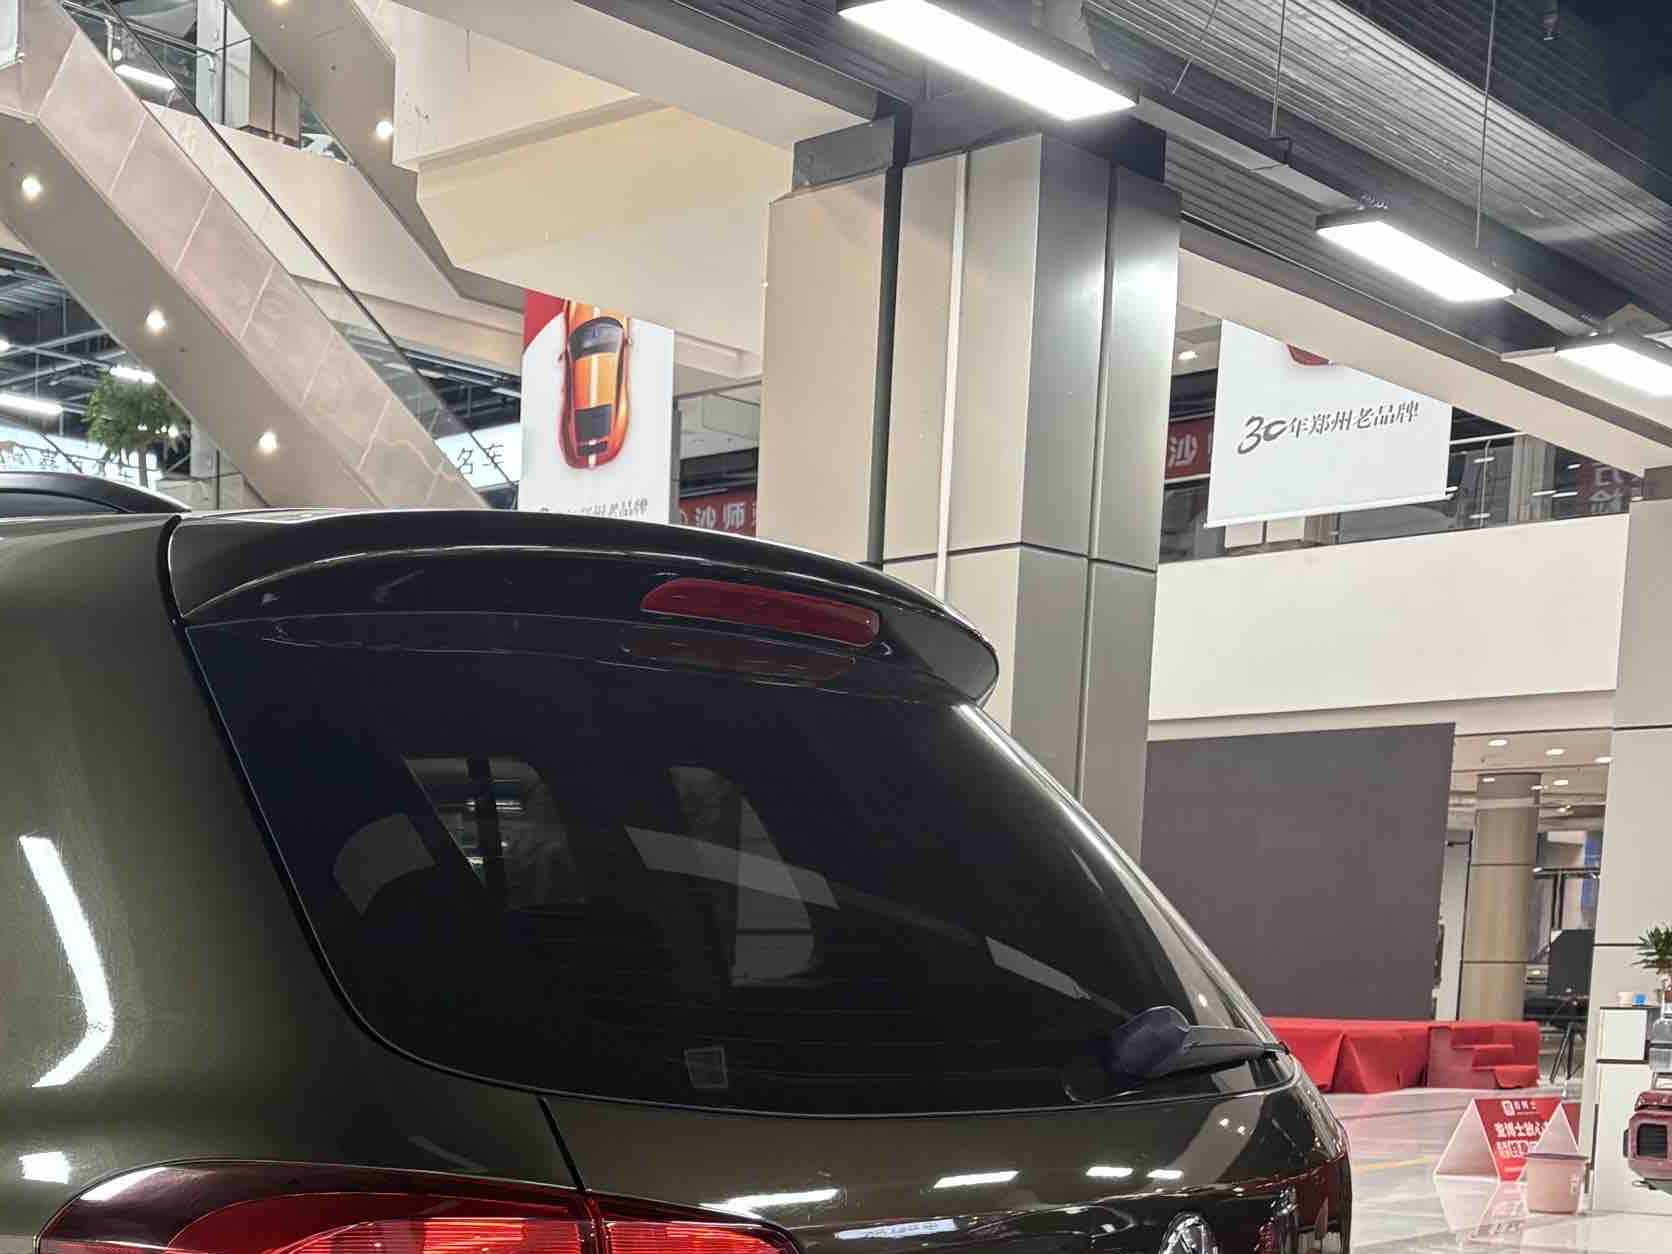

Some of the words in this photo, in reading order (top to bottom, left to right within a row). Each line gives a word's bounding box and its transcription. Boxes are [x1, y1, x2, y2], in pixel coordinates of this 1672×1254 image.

[1237, 400, 1420, 455] 30年郑州老品牌
[1167, 433, 1212, 468] 沙
[696, 501, 757, 530] 沙师
